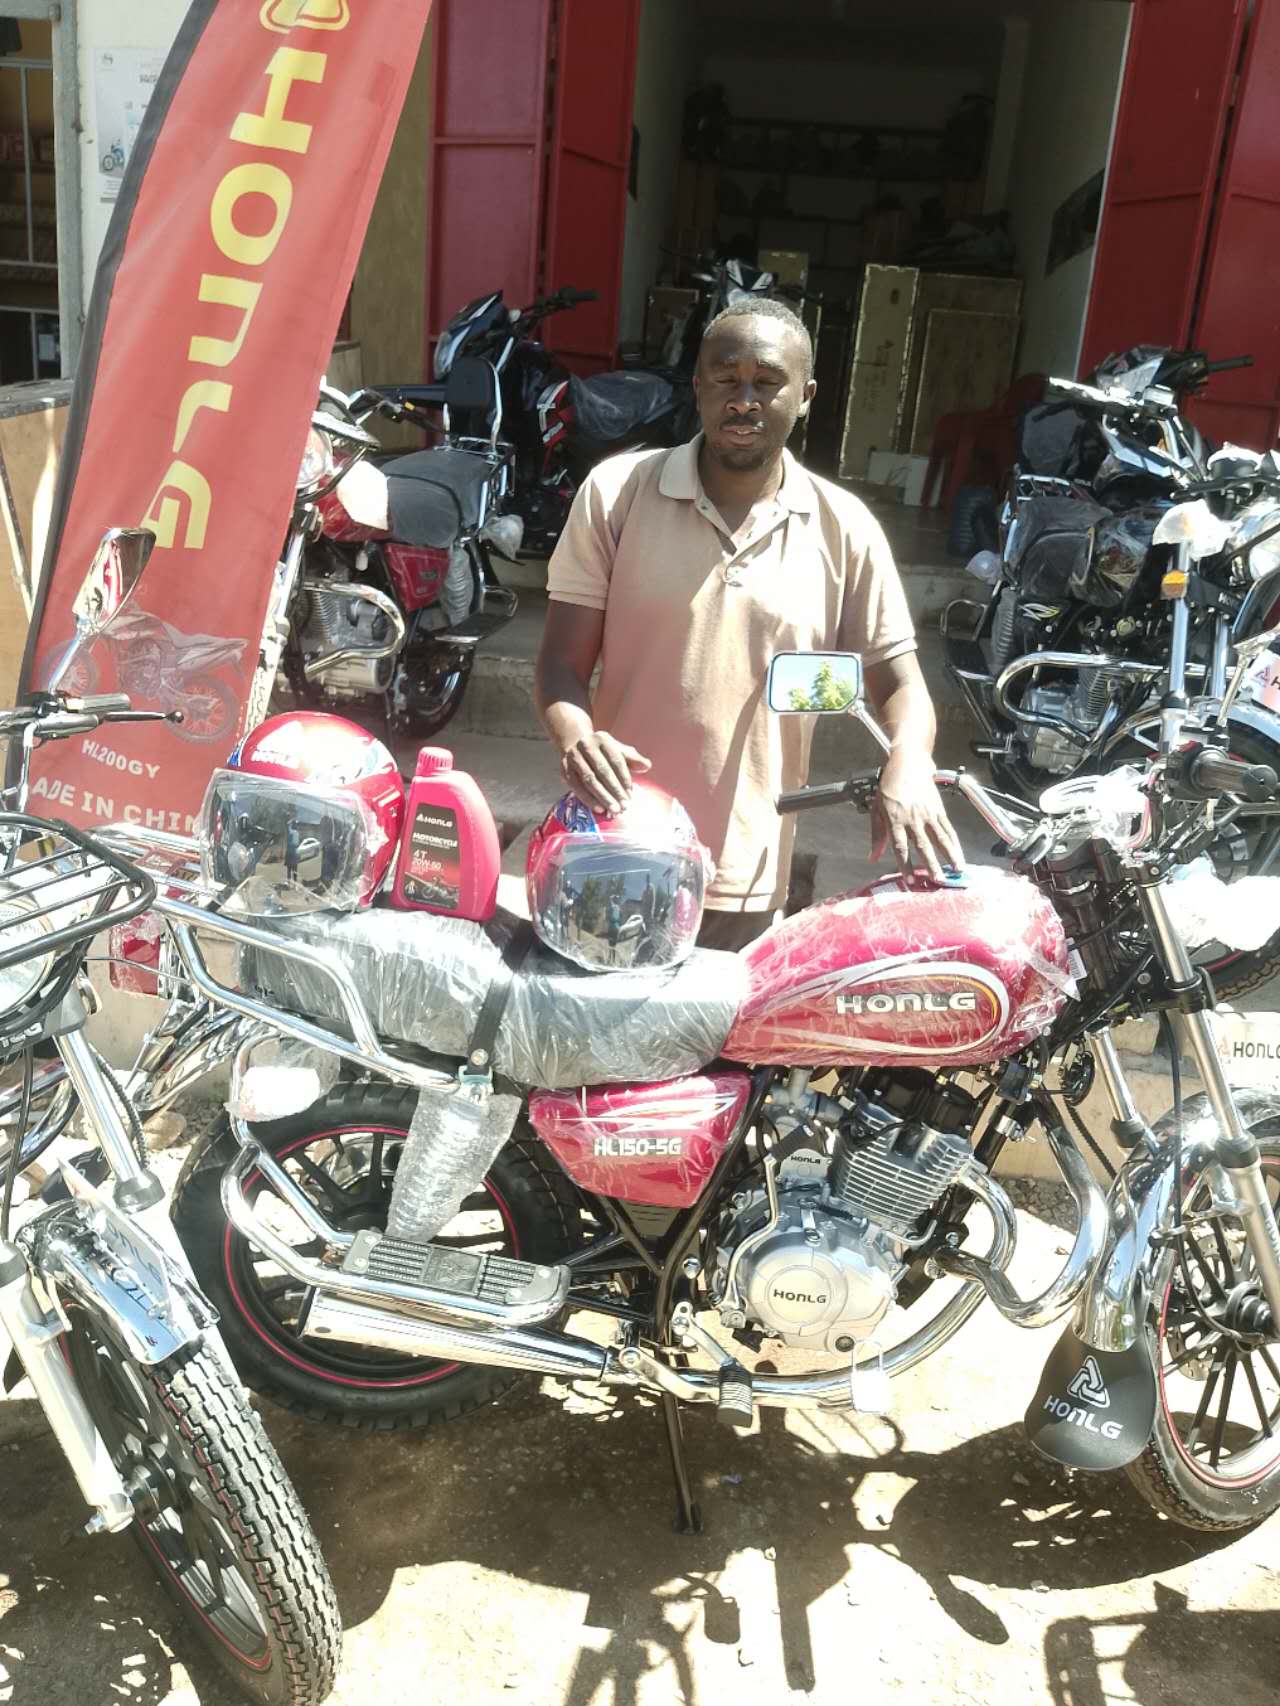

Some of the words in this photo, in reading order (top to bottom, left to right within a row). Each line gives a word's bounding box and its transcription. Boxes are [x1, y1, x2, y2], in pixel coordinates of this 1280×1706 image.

[141, 47, 328, 550] HONLG
[82, 739, 161, 779] HL200GY
[32, 776, 76, 808] ADE
[81, 791, 114, 819] IN
[124, 804, 200, 834] CHIN
[836, 991, 976, 1015] HONLG
[772, 1288, 827, 1305] HONLG
[1043, 1394, 1124, 1440] HONLG
